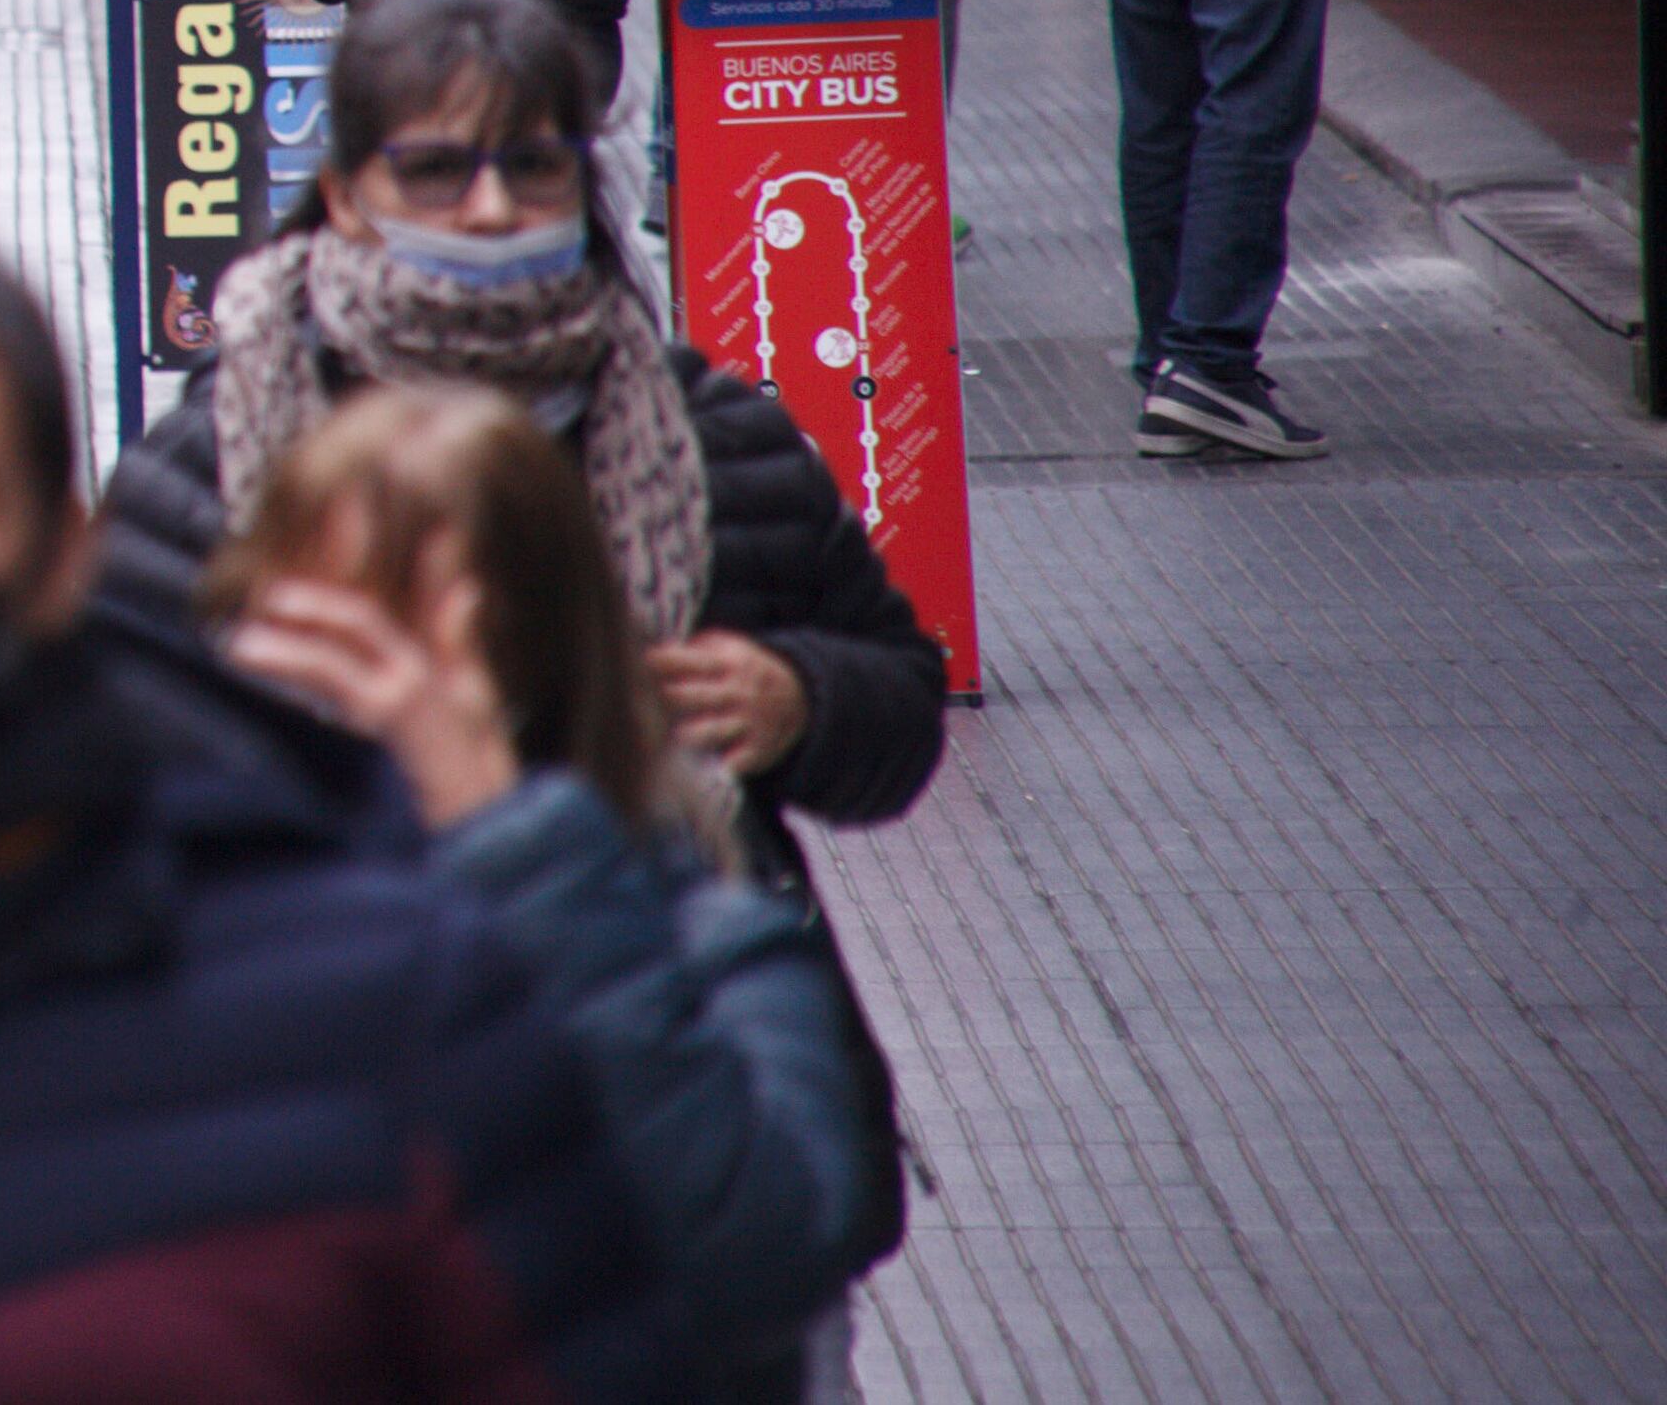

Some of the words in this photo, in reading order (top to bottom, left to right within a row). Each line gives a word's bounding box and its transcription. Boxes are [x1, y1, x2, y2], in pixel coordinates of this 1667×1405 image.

[711, 1, 774, 16] Servicios
[777, 0, 811, 13] cada
[722, 53, 823, 79] BUENOS
[829, 51, 897, 73] AIRES
[723, 79, 810, 111] CITY
[820, 75, 899, 107] BUS
